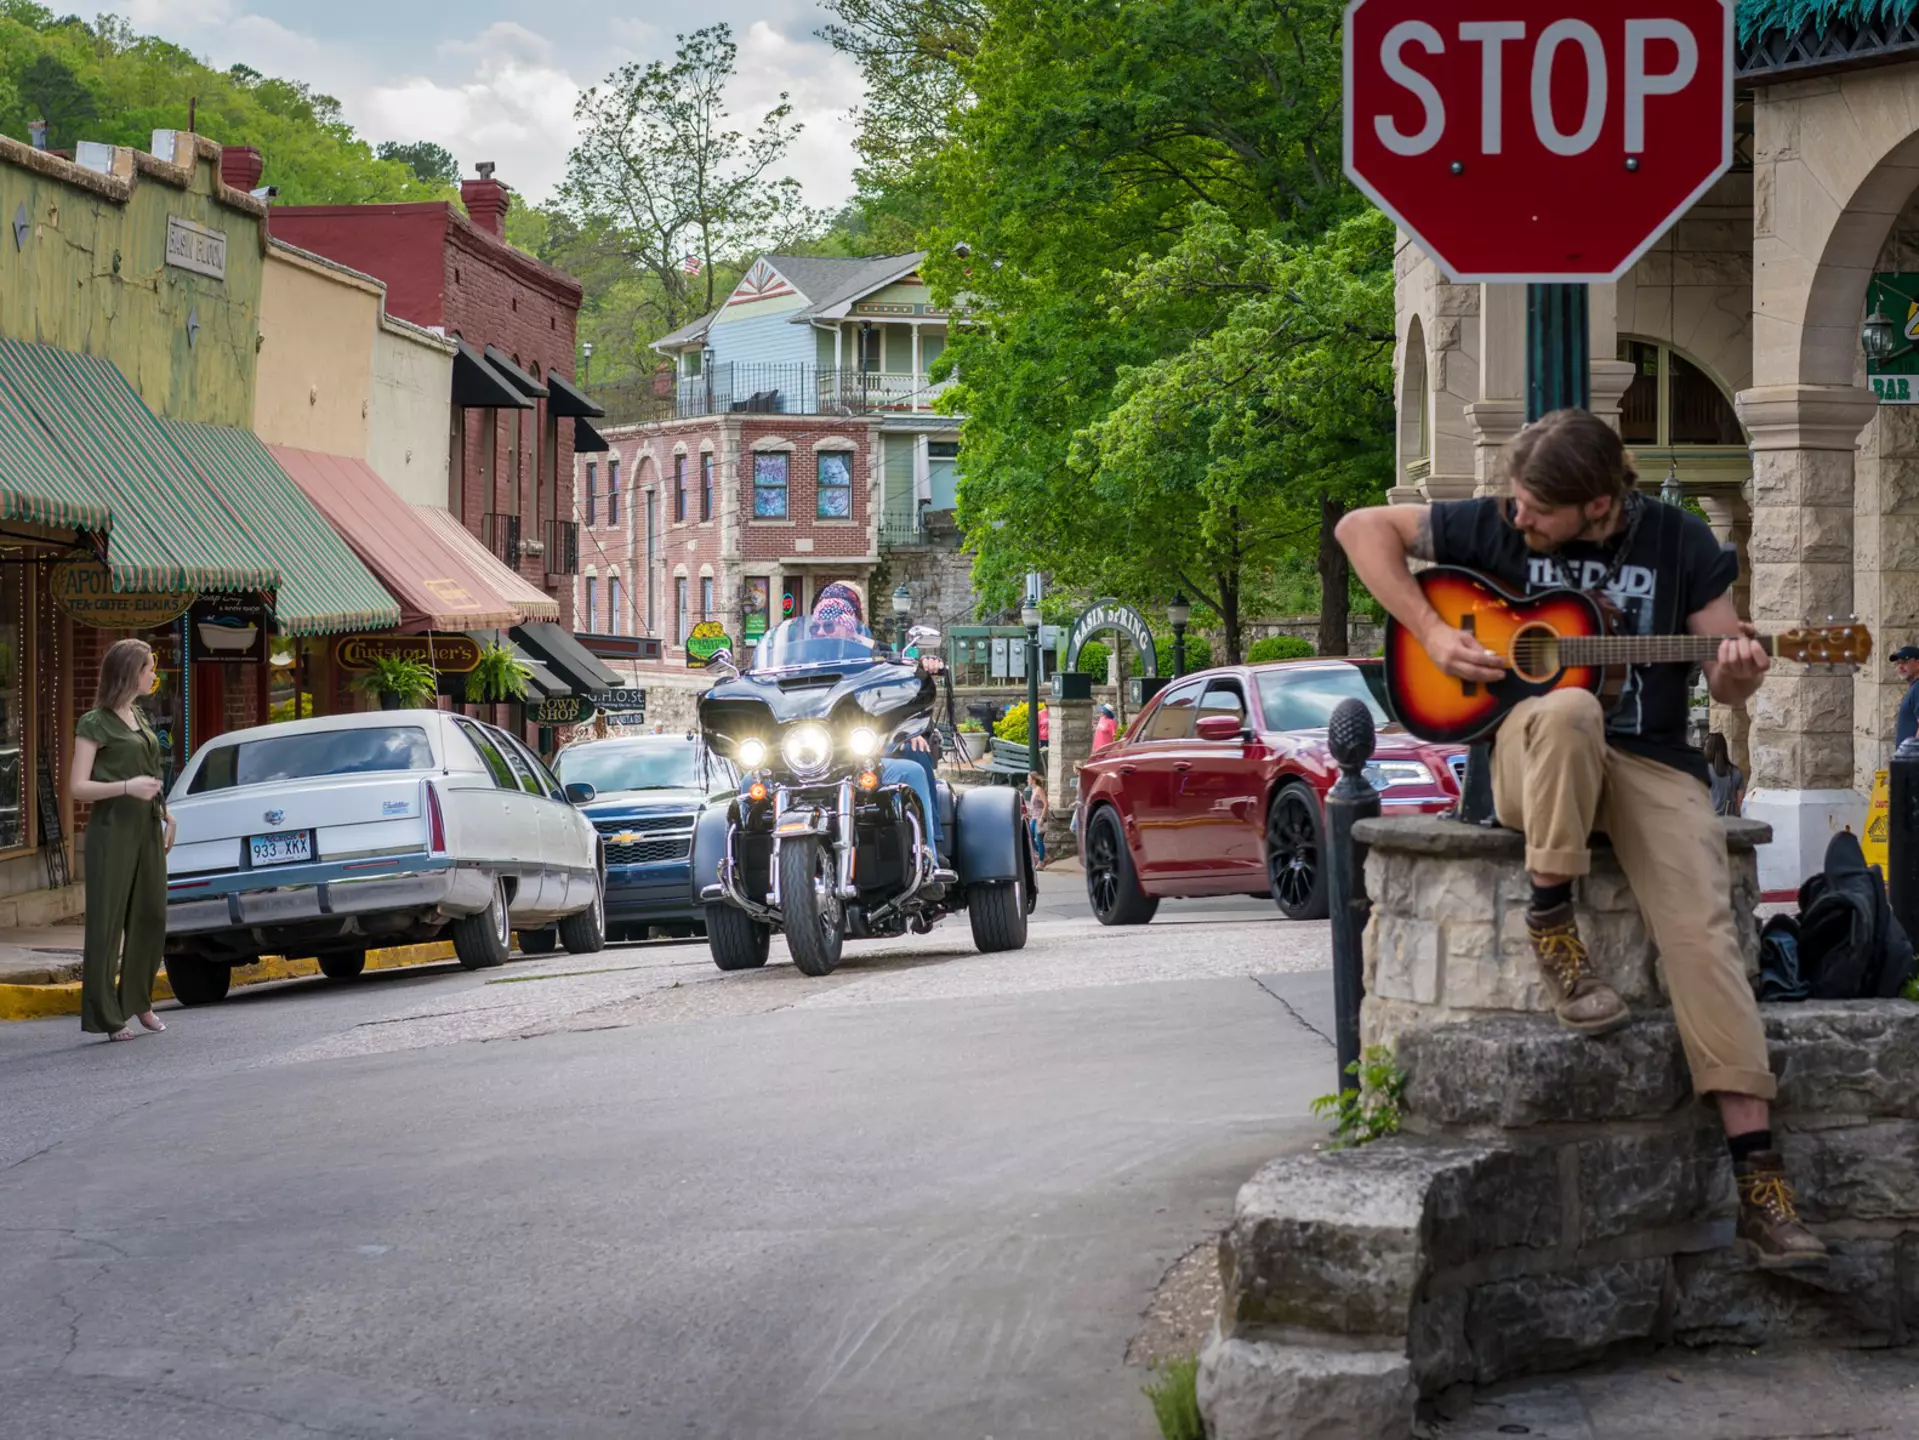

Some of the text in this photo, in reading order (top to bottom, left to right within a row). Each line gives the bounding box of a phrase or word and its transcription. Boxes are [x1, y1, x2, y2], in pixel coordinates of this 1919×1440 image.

[1374, 18, 1698, 156] STOP
[168, 225, 223, 271] BASIN BLOCK
[1873, 379, 1911, 400] BAR
[1581, 561, 1655, 595] DUD
[1074, 605, 1149, 651] BASIN SPRING
[344, 641, 472, 663] Christopher's
[540, 698, 580, 709] TOWN
[538, 709, 579, 721] SHOP
[253, 839, 307, 858] 933 XKX
